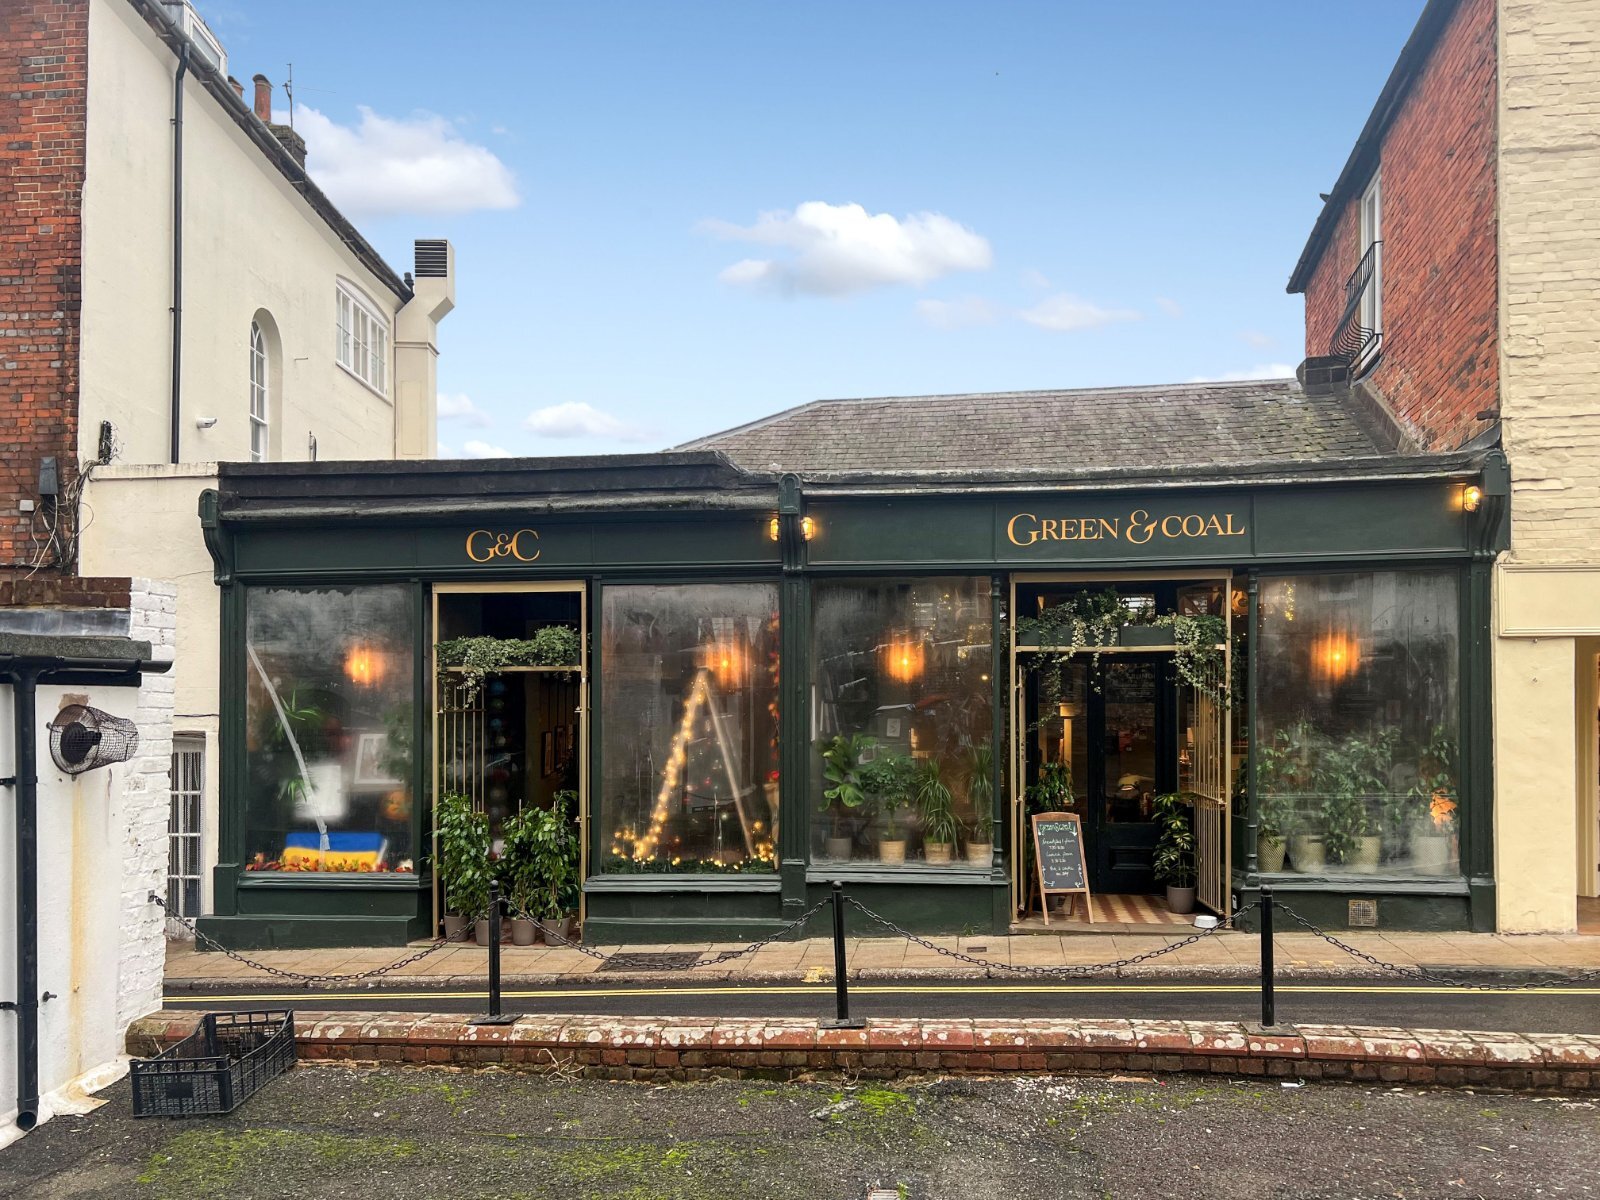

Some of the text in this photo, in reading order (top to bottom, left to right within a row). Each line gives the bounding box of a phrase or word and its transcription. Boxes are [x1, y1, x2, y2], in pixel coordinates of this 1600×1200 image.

[1007, 509, 1245, 546] GREEN & COAL
[465, 529, 540, 562] G&C
